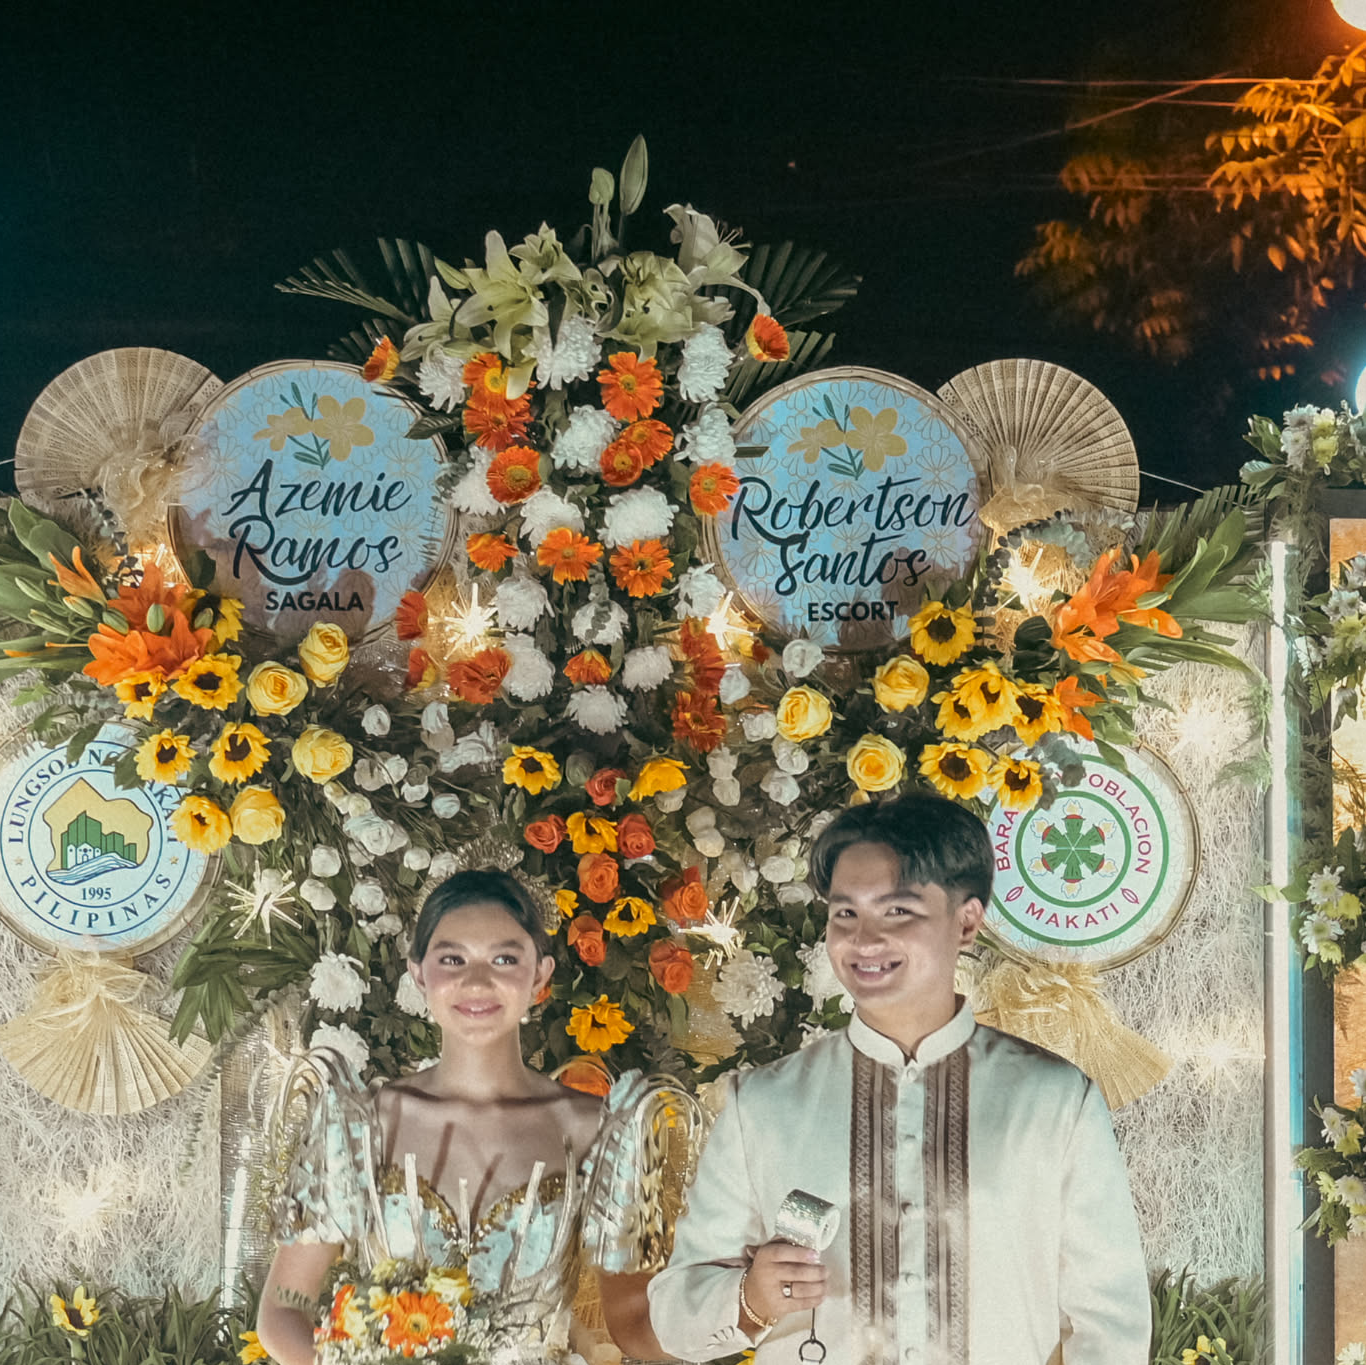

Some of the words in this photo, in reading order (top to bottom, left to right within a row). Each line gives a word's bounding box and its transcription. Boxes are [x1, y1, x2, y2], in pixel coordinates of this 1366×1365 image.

[222, 458, 412, 519] Azemie
[727, 476, 976, 546] Robertson
[229, 514, 403, 586] Ramos
[775, 530, 931, 596] Santos
[265, 591, 364, 612] SAGALA
[807, 601, 899, 623] ESCORT
[1084, 773, 1152, 874] OBLACION
[21, 873, 172, 928] PILIPINAS
[81, 887, 112, 900] 1995
[1025, 902, 1120, 929] MAKATI
